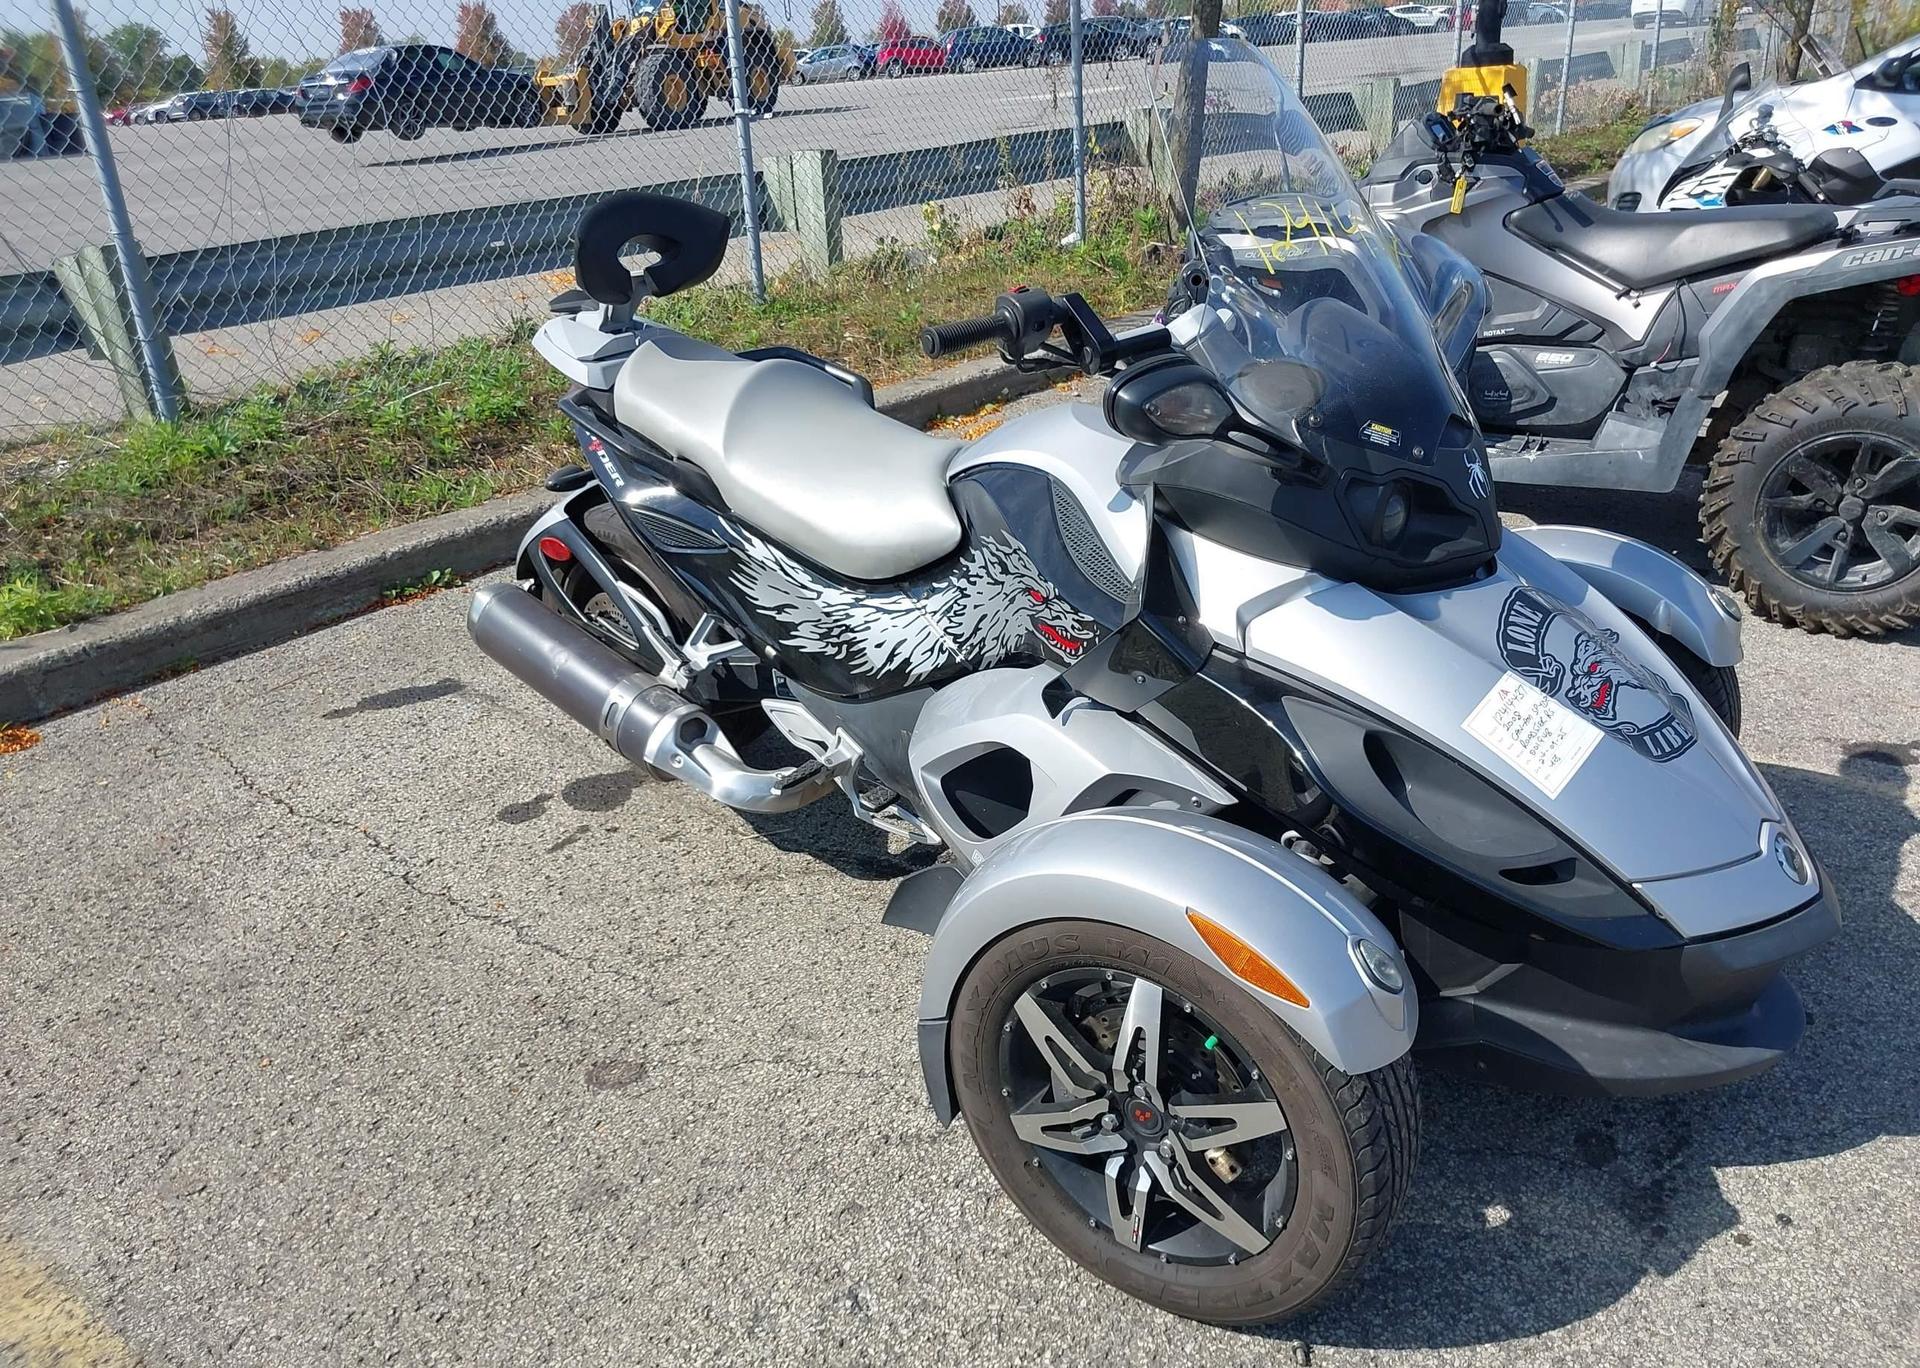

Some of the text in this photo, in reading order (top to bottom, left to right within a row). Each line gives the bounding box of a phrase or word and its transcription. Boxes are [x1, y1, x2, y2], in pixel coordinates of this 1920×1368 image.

[1483, 328, 1506, 337] ROTAX
[1535, 352, 1575, 361] 850
[1506, 600, 1544, 656] LONE
[1503, 711, 1522, 732] 2008
